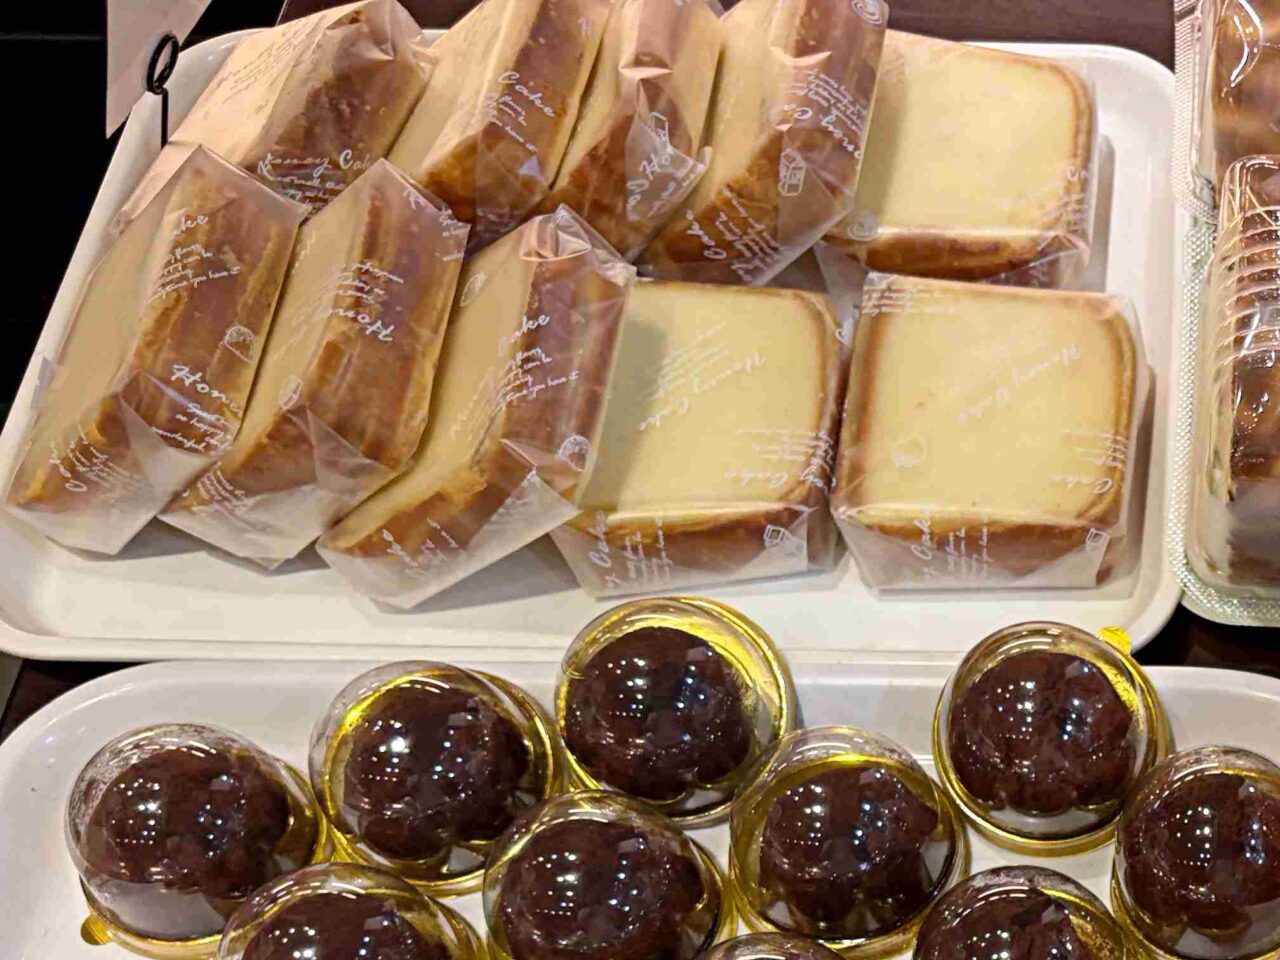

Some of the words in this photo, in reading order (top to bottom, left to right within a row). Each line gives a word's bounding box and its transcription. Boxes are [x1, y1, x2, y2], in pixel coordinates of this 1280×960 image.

[499, 72, 555, 116] Cake
[820, 115, 864, 160] oney
[338, 149, 370, 170] Cak
[171, 215, 209, 240] ake
